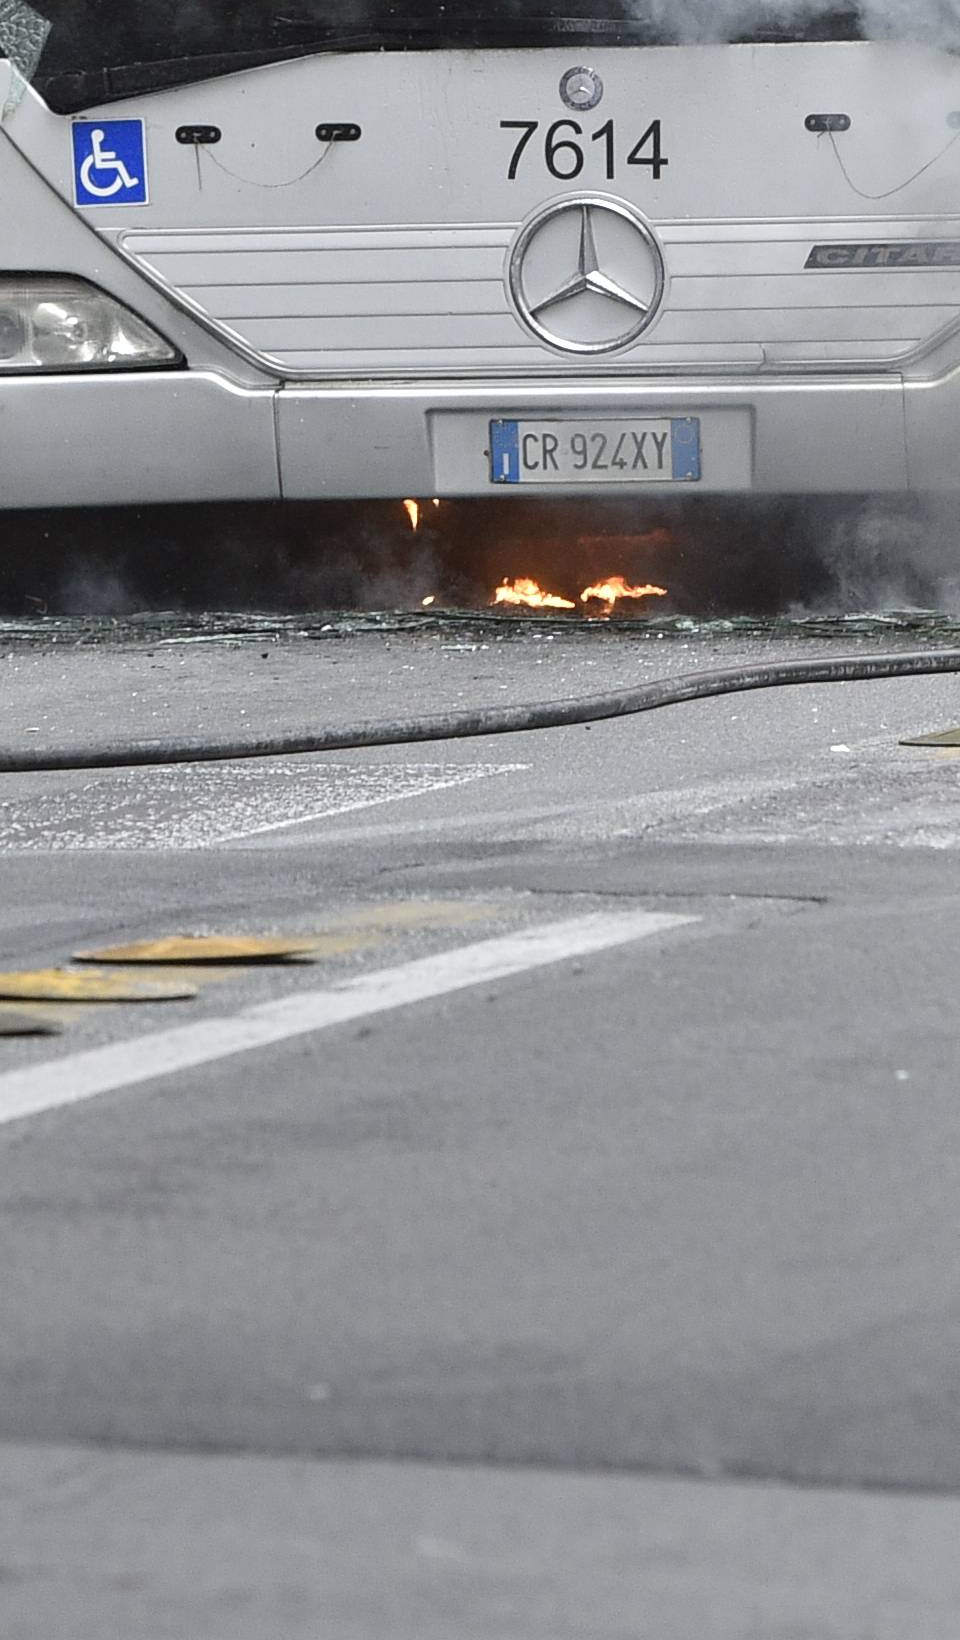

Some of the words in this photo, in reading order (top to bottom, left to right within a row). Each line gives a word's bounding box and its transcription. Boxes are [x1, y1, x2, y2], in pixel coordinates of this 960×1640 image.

[500, 119, 669, 180] 7614
[522, 433, 559, 470] CR
[570, 431, 668, 470] 924XY
